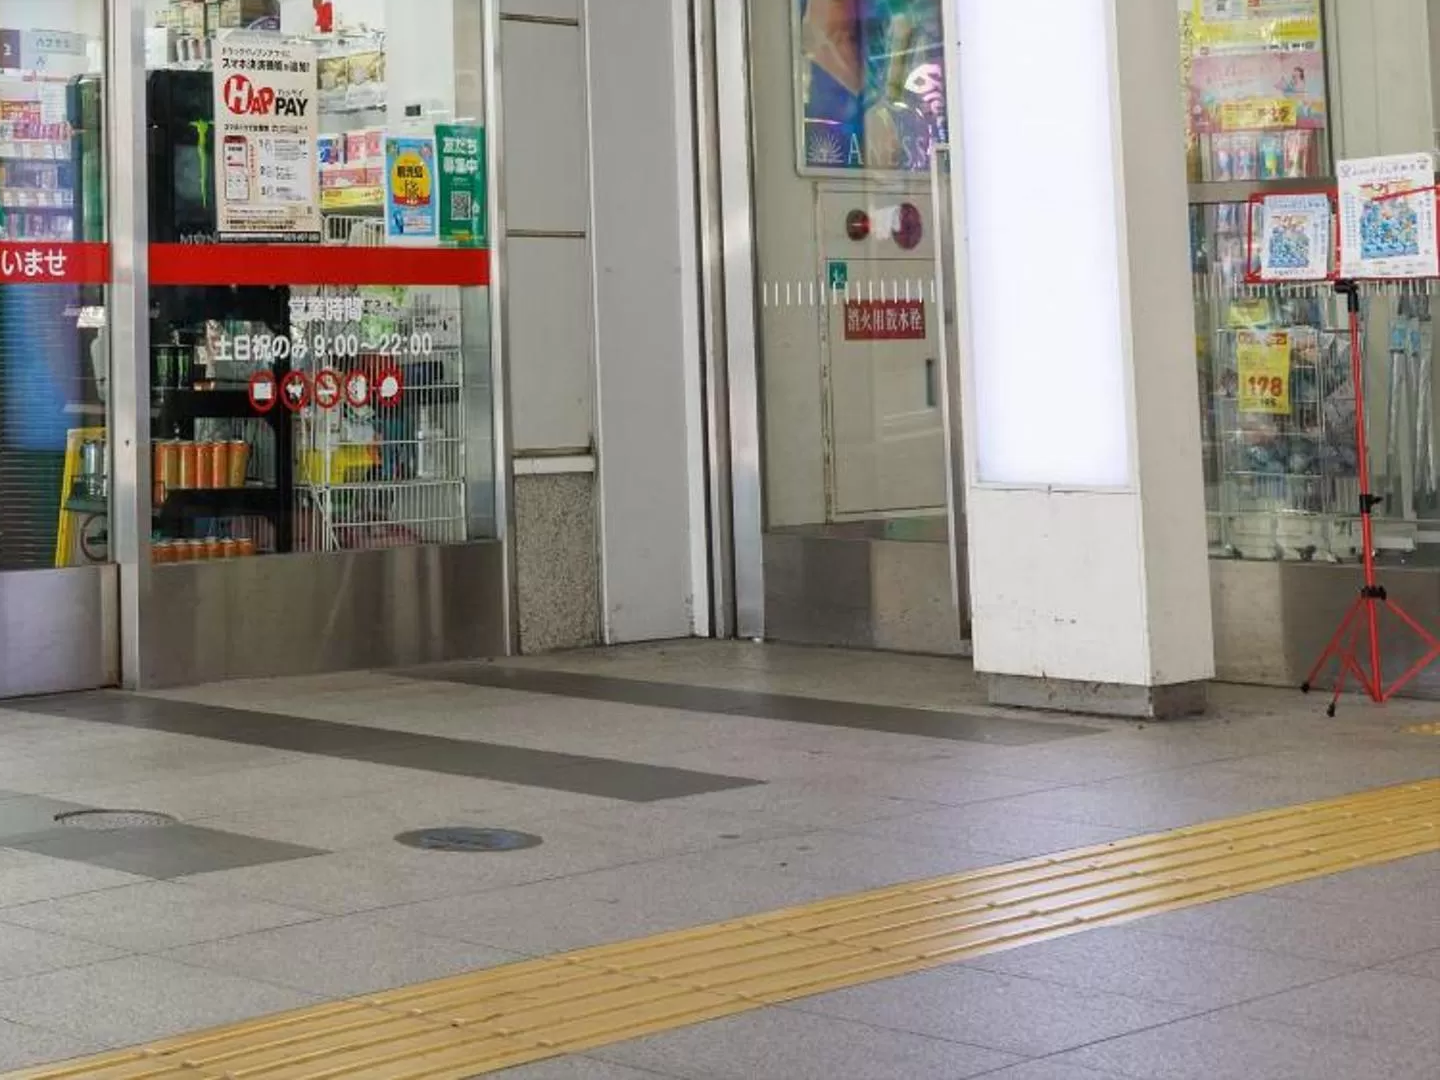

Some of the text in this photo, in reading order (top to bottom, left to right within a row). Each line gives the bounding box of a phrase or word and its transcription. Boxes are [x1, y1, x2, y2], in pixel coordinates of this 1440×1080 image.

[289, 297, 362, 322] 営業時間
[847, 306, 923, 333] 消火用散水栓
[215, 333, 309, 362] 土日祝のみ
